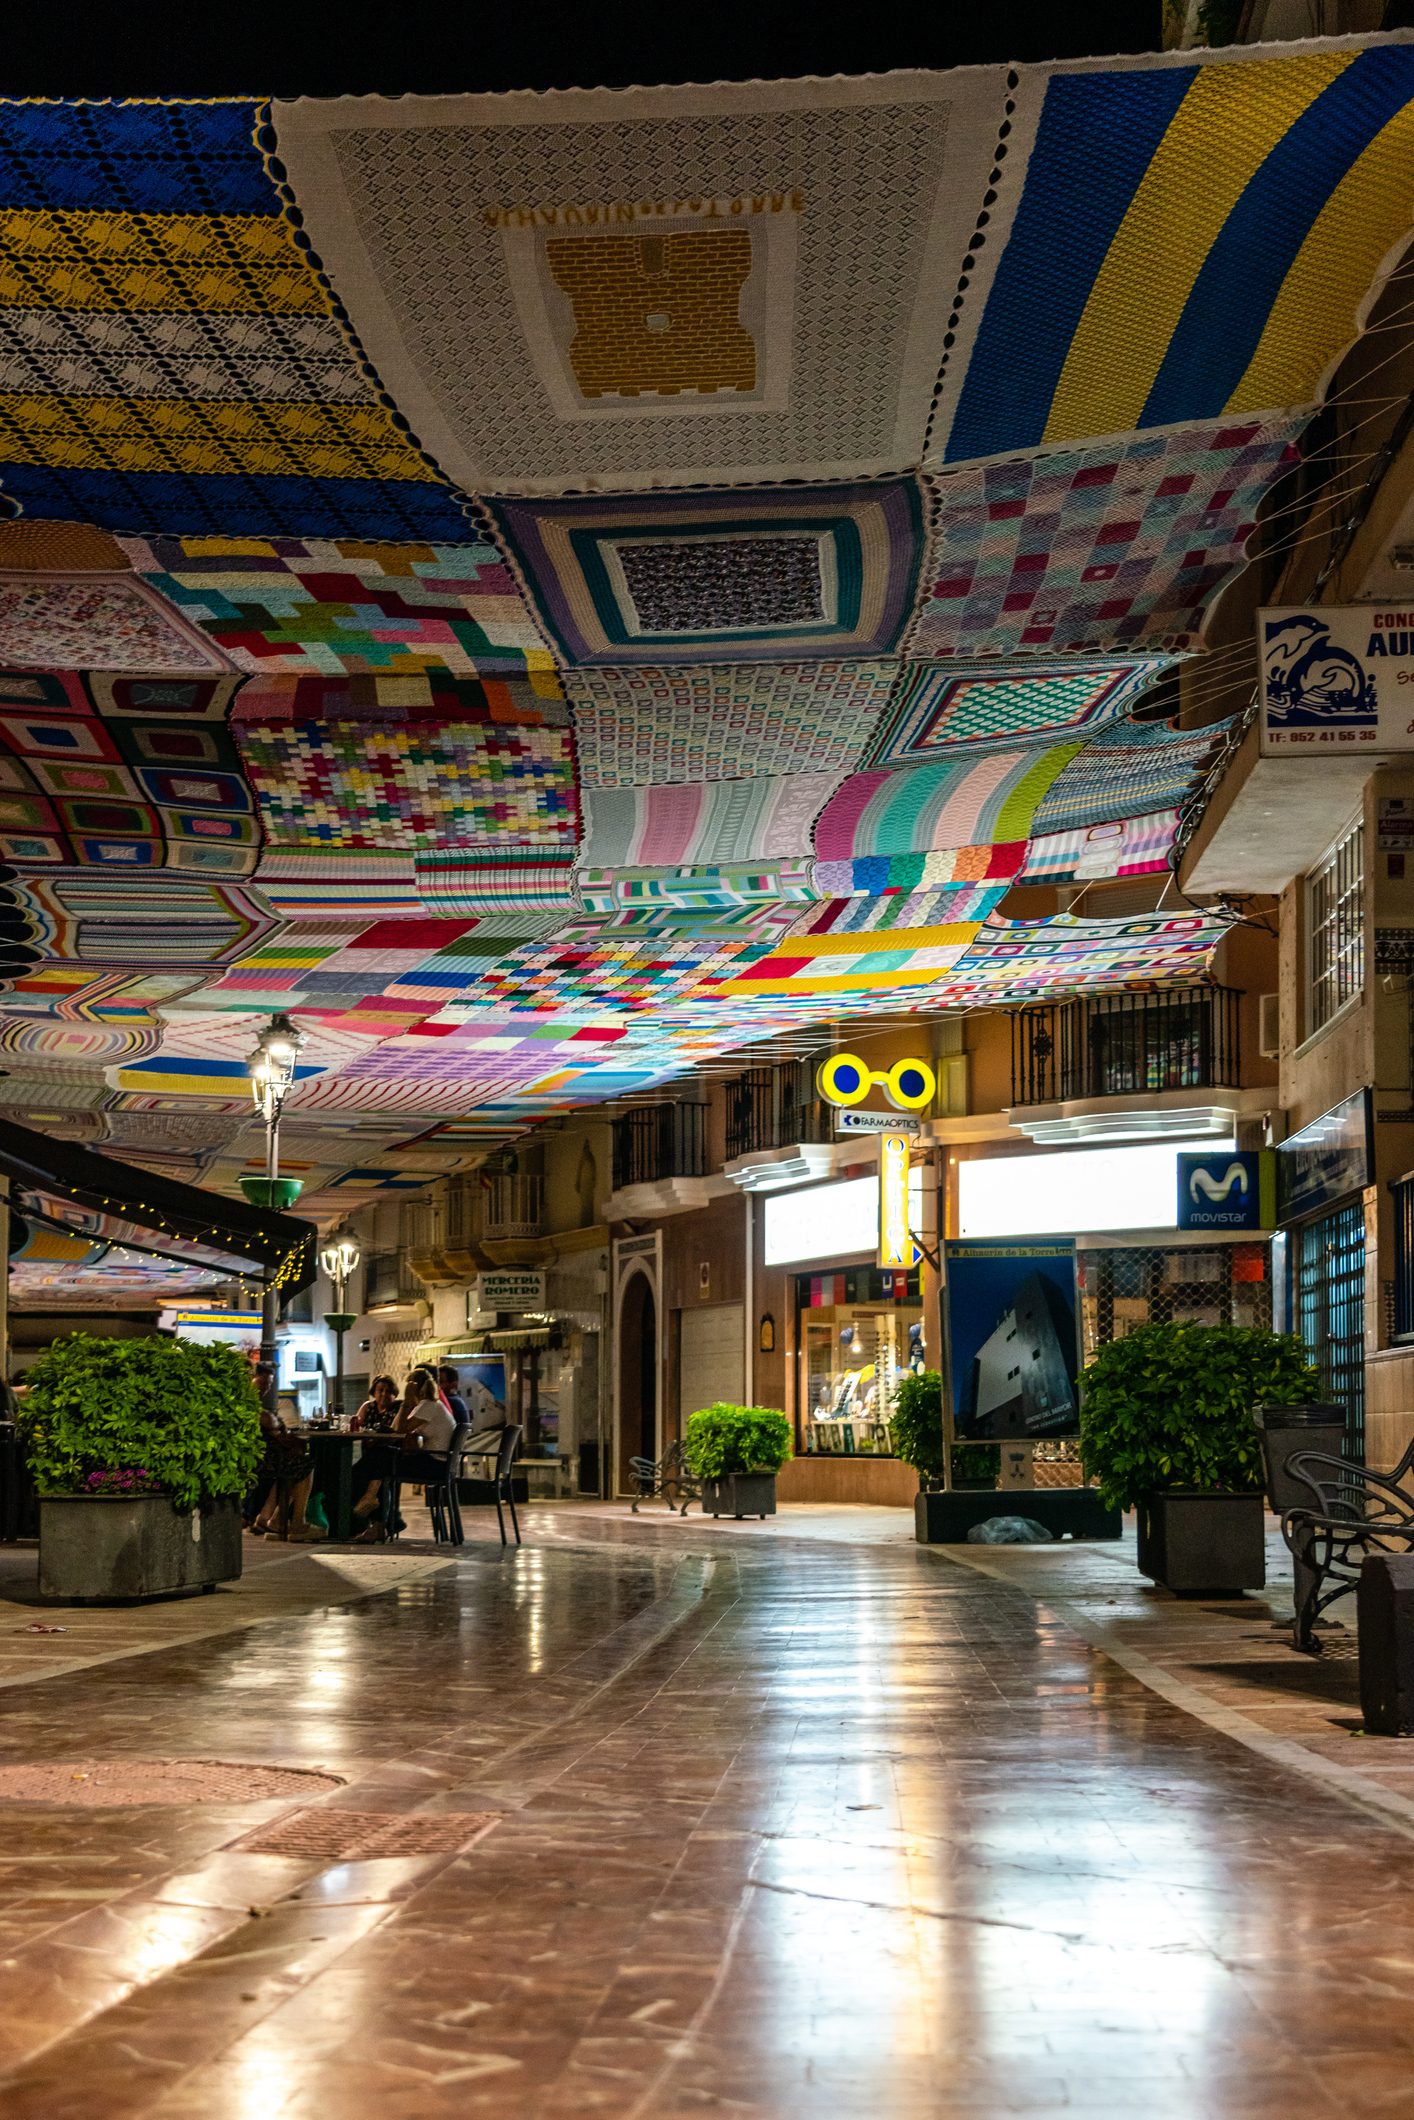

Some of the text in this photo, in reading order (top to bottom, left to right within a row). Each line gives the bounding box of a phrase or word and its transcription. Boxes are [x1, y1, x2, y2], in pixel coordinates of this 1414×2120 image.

[1320, 731, 1335, 742] 41
[1338, 730, 1356, 741] 55
[1359, 730, 1377, 741] 35
[861, 1117, 919, 1128] FARMAOPTICS
[1190, 1212, 1247, 1223] movistar
[485, 1286, 539, 1295] ROMERO
